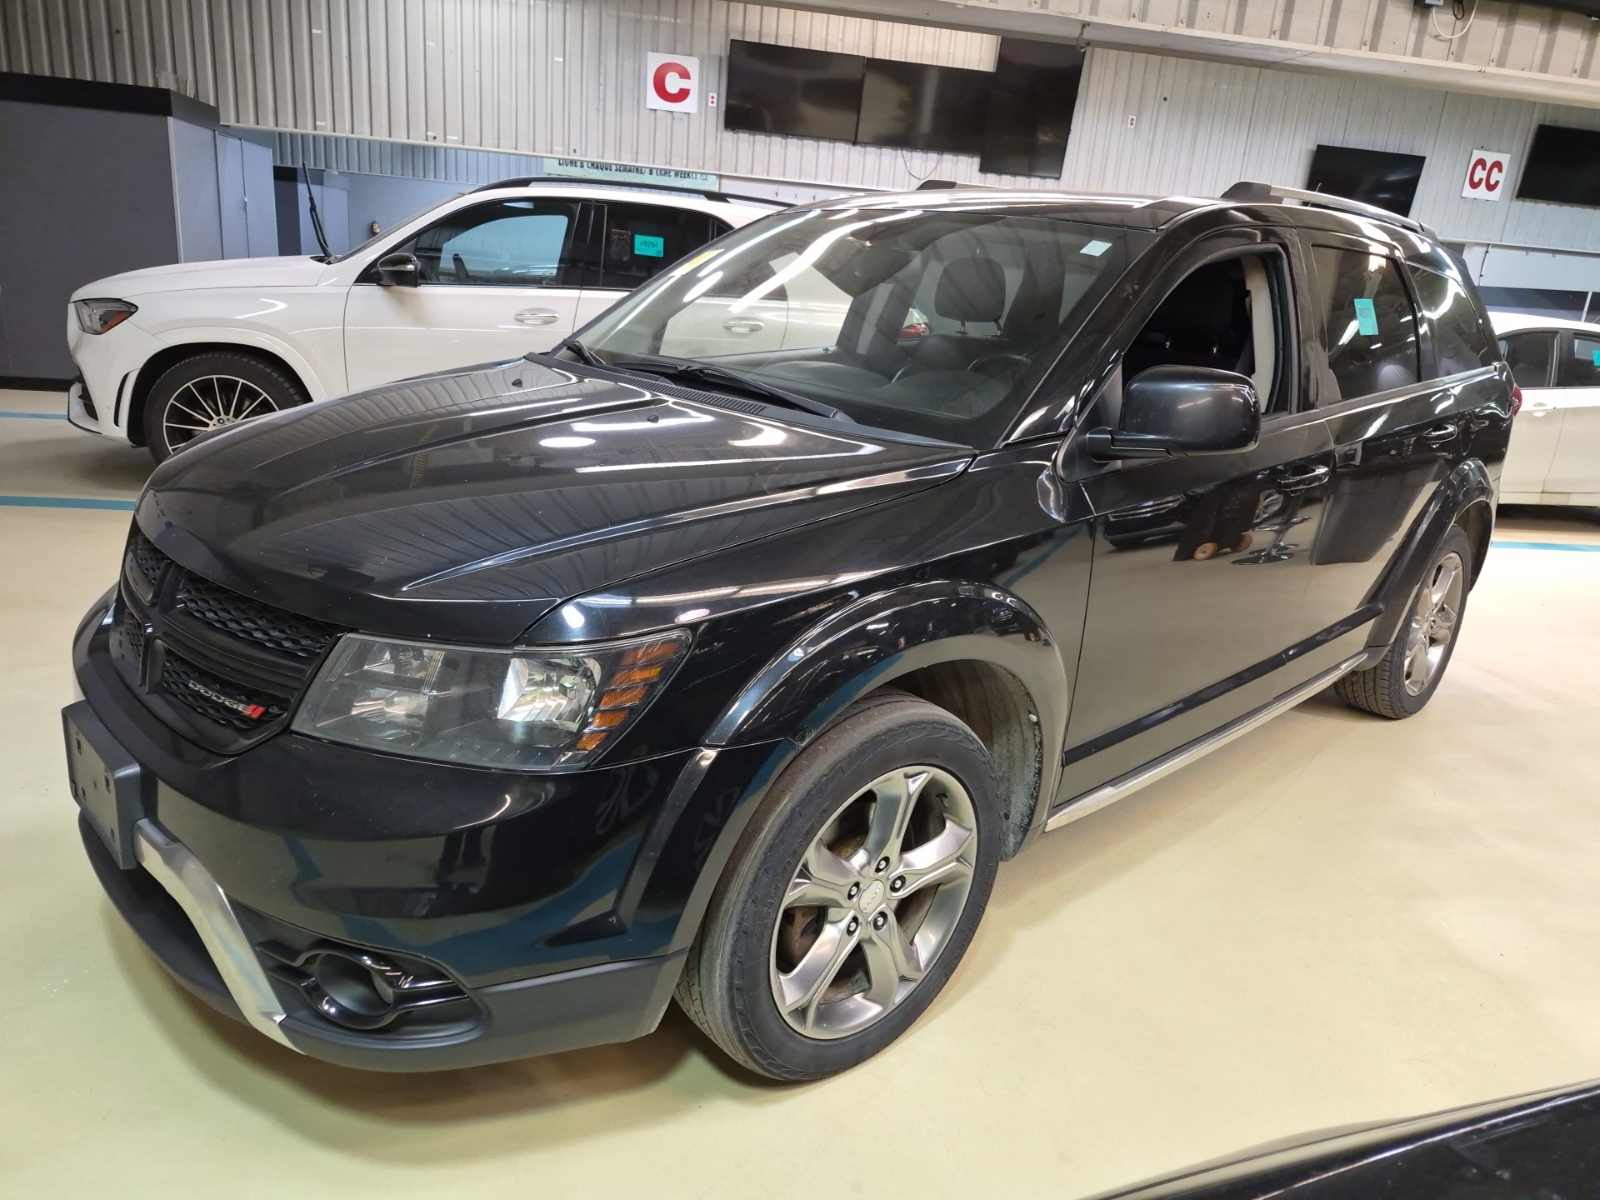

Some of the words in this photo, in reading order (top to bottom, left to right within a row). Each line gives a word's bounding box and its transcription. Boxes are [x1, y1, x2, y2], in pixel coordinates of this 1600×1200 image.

[653, 62, 691, 103] C
[1469, 157, 1503, 192] CC
[188, 679, 252, 716] DODGE
